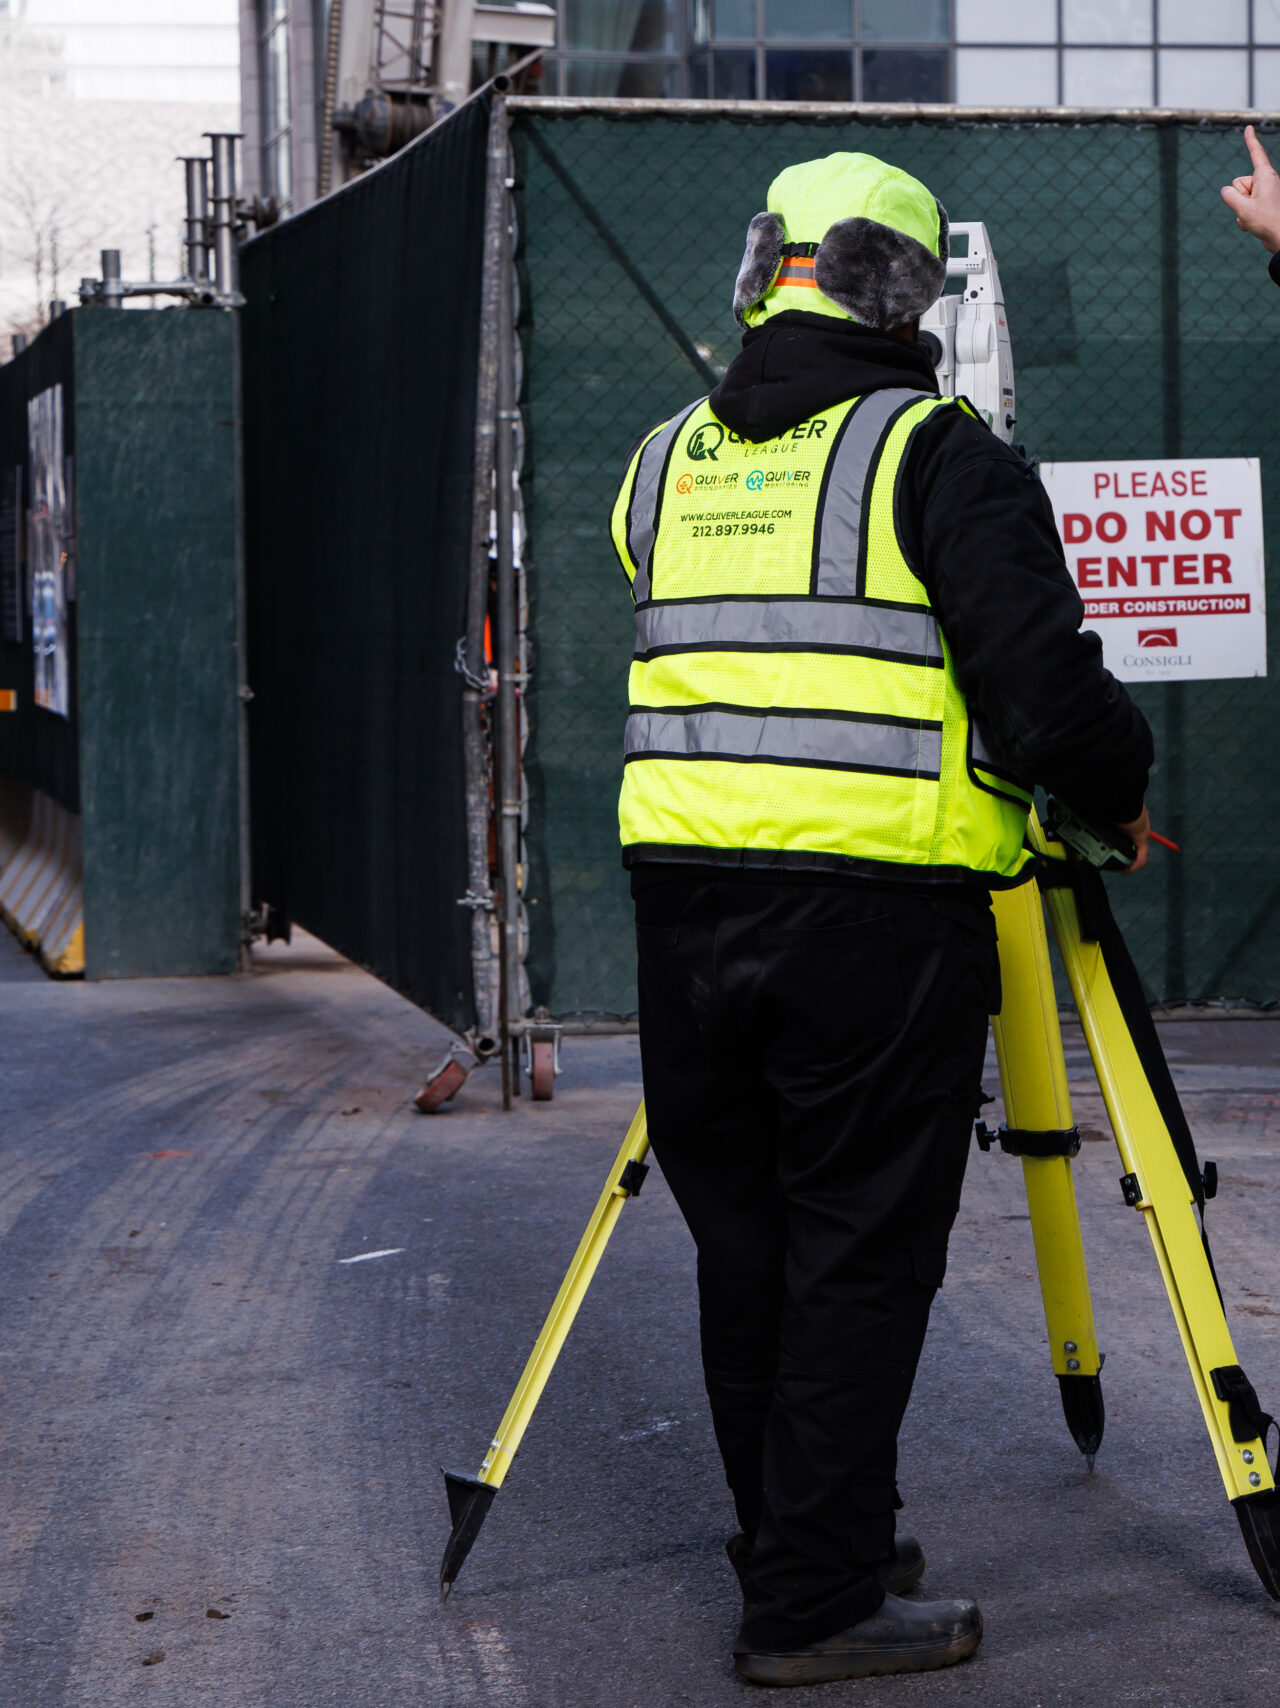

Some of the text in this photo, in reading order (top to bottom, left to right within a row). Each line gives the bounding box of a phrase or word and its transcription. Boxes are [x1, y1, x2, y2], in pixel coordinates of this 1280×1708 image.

[744, 442, 799, 458] LEAGUE
[695, 472, 739, 486] QUIVER
[765, 470, 811, 482] QUIVER
[1094, 470, 1208, 499] PLEASE
[681, 510, 792, 522] WWW.QUIVERLEAGUE.COM
[692, 523, 775, 537] 212.897.9946
[1063, 508, 1242, 544] DO NOT
[1077, 553, 1233, 588] ENTER
[1123, 598, 1246, 613] CONSTRUCTION
[1123, 654, 1192, 667] CONSIGLI
